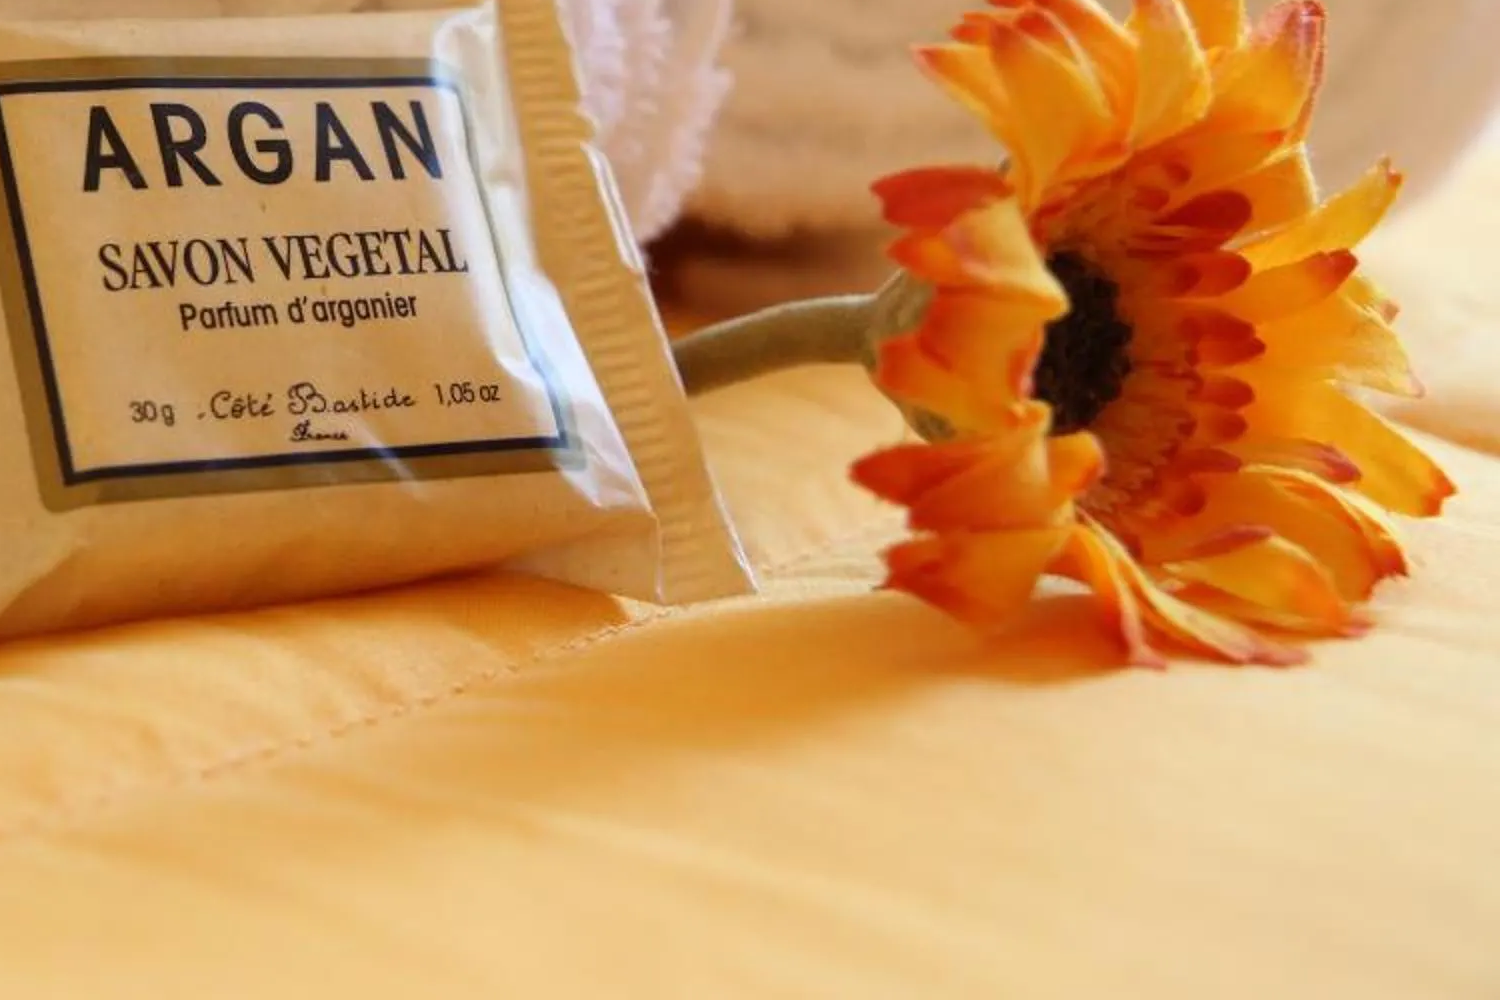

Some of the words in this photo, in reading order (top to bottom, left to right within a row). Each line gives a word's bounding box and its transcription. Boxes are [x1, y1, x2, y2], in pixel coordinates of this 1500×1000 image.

[82, 101, 443, 192] ARGAN
[99, 237, 255, 292] SAVON
[262, 229, 469, 281] VEGETAL
[179, 302, 278, 331] Parfum
[287, 293, 417, 326] d'arganier
[288, 381, 416, 415] Bastide
